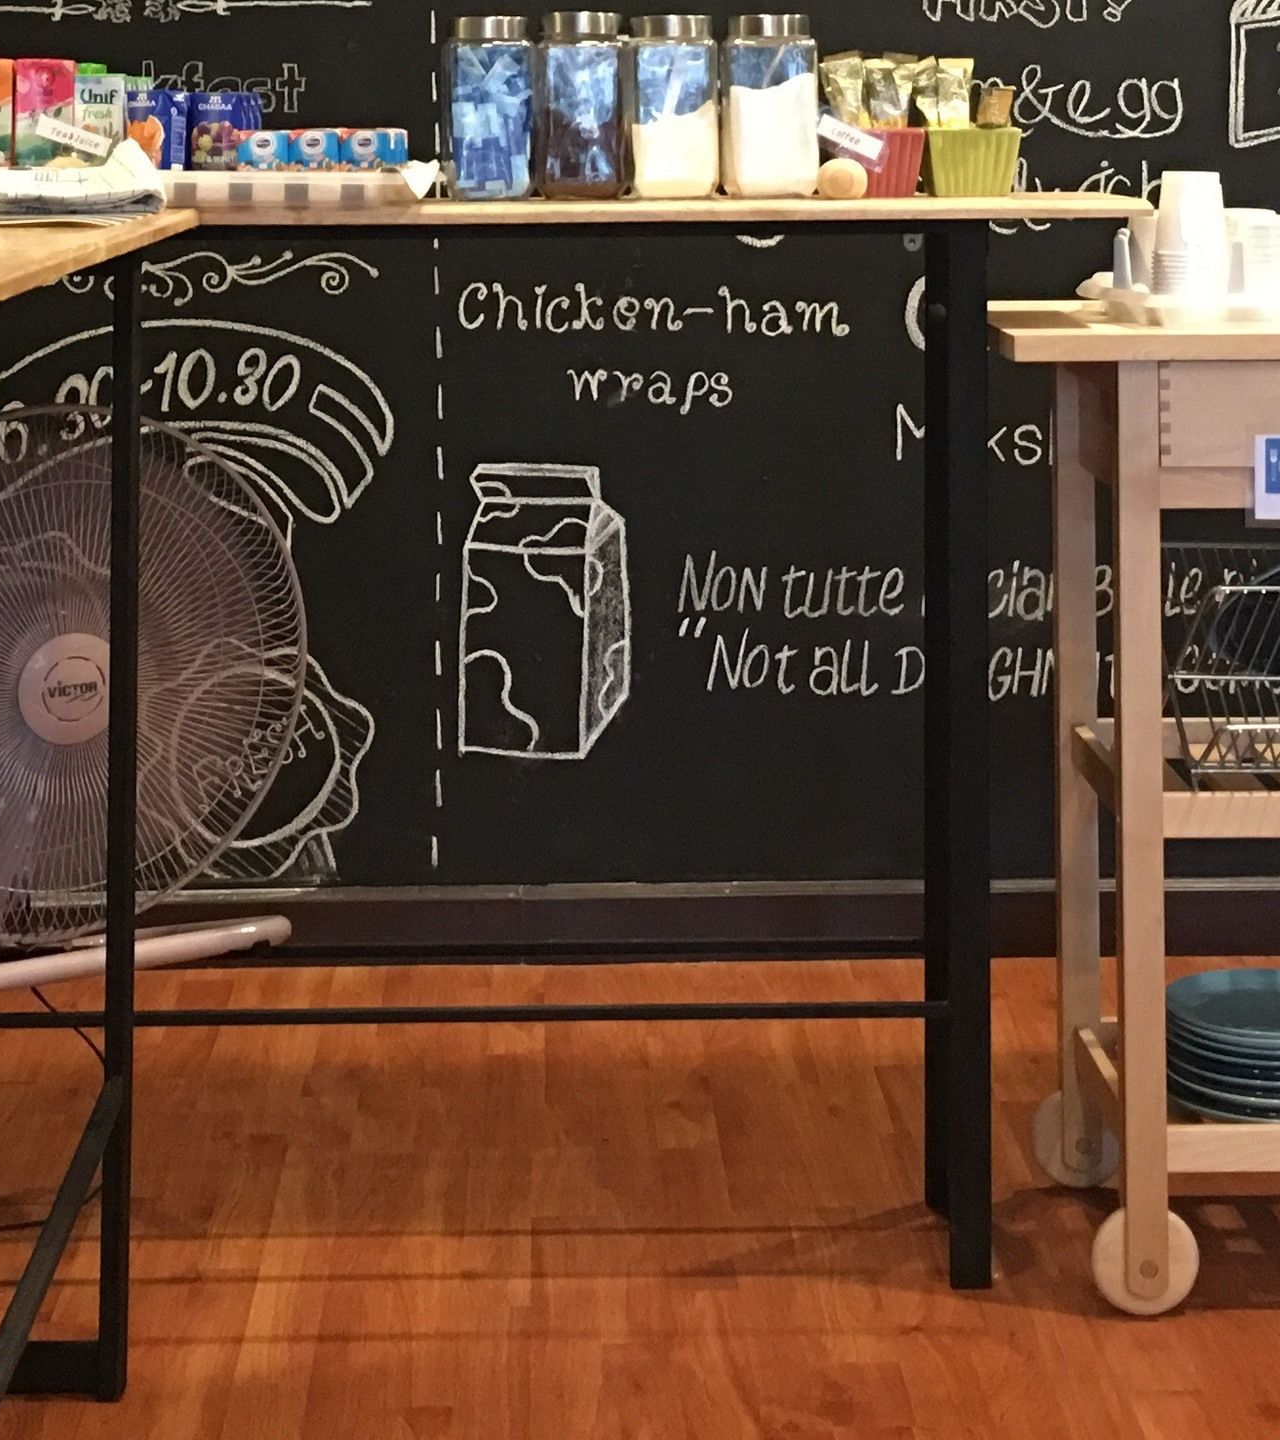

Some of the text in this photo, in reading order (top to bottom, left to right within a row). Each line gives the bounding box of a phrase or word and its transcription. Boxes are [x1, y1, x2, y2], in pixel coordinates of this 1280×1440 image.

[80, 88, 118, 105] Unif
[457, 281, 851, 338] Chicken-ham
[566, 367, 734, 415] wraps
